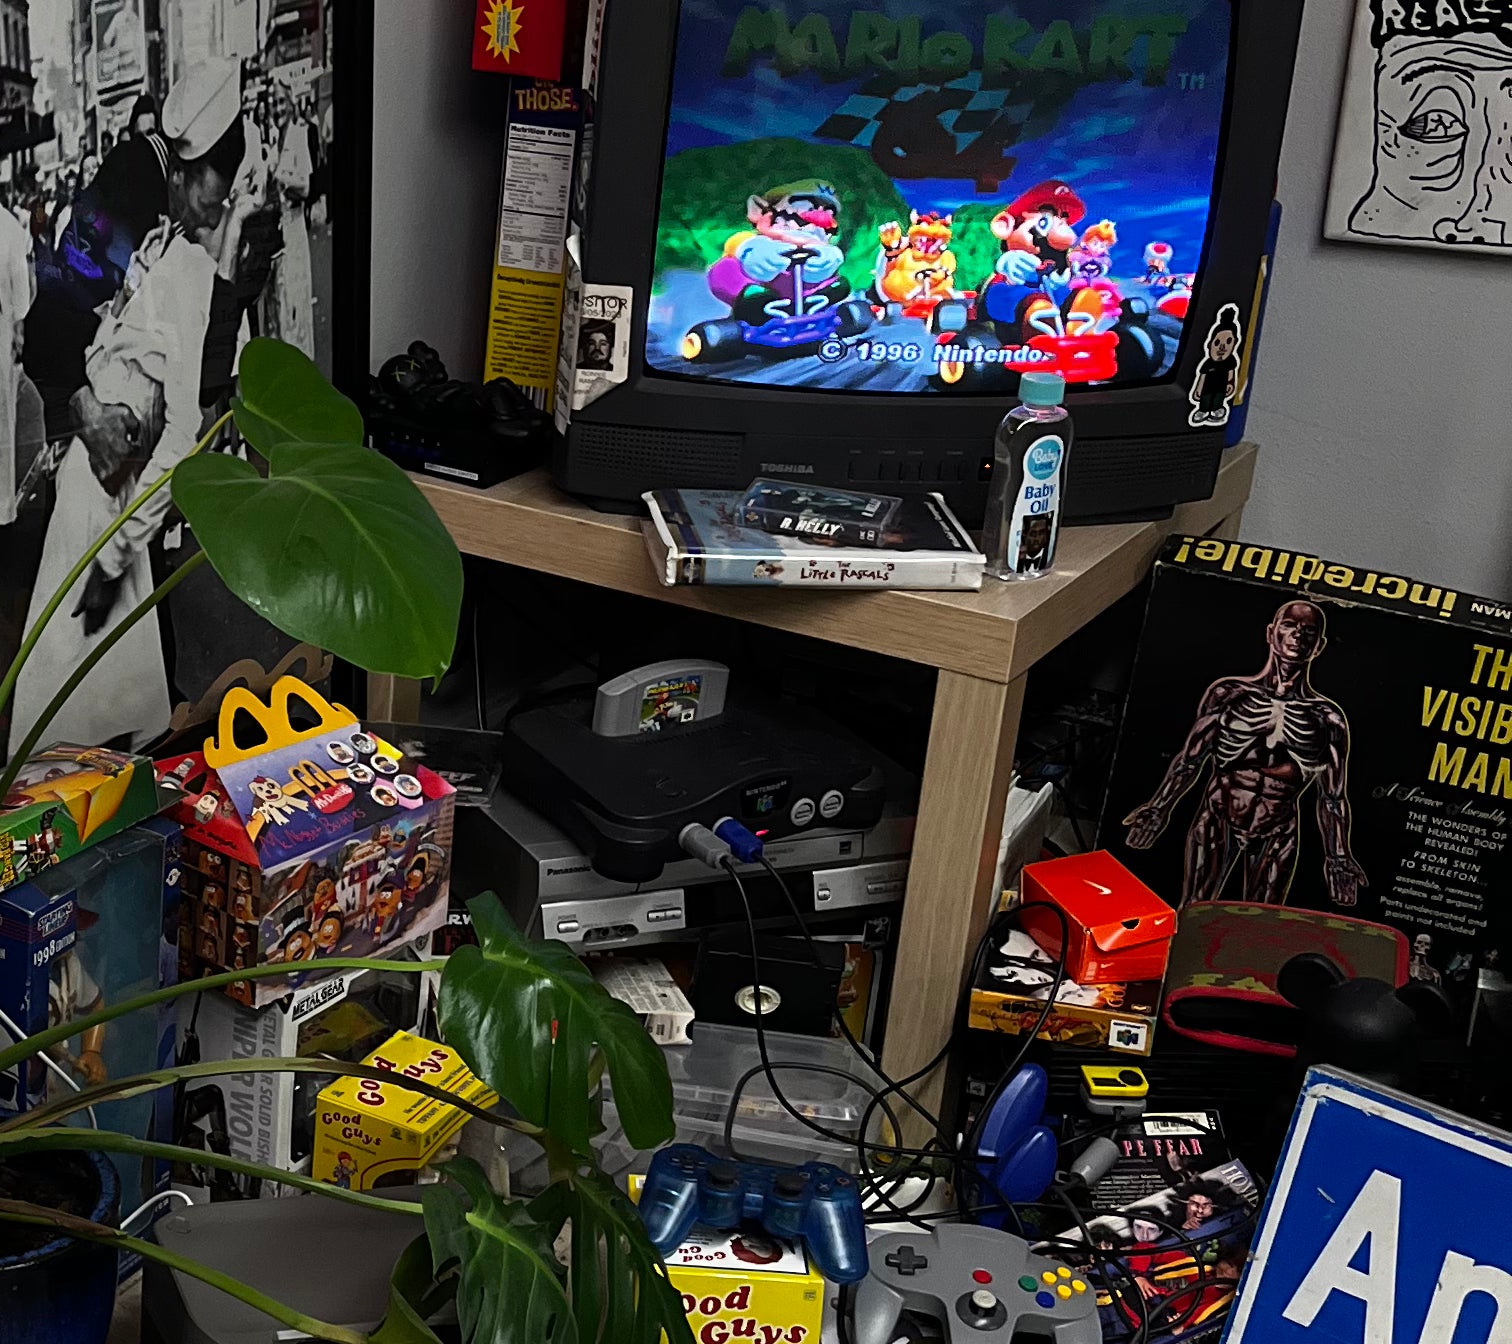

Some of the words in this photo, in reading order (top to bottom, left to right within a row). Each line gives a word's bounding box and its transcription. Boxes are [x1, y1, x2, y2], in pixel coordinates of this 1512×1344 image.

[720, 6, 972, 82] MARIO
[983, 13, 1189, 86] KART
[856, 342, 920, 362] 1996
[760, 463, 815, 474] TOSHIBA
[1025, 484, 1055, 499] Baby
[1030, 499, 1048, 514] Oil
[1174, 537, 1457, 617] incredible!
[1408, 811, 1427, 822] THE
[1432, 817, 1486, 836] WONDERS
[1492, 831, 1507, 841] OF
[1406, 822, 1423, 833] THE
[1428, 827, 1469, 844] HUMAN
[1474, 838, 1504, 852] BODY
[1401, 859, 1415, 868] TO
[1414, 851, 1448, 864] FROM
[1453, 859, 1481, 873] SKIN
[33, 940, 55, 966] 1998
[56, 931, 75, 953] EDITION
[292, 991, 320, 1019] METAL
[320, 978, 345, 1002] GEAR
[322, 1111, 361, 1125] Good
[342, 1127, 381, 1146] Guys
[1153, 1138, 1203, 1156] FEAR
[681, 1286, 751, 1315] ood
